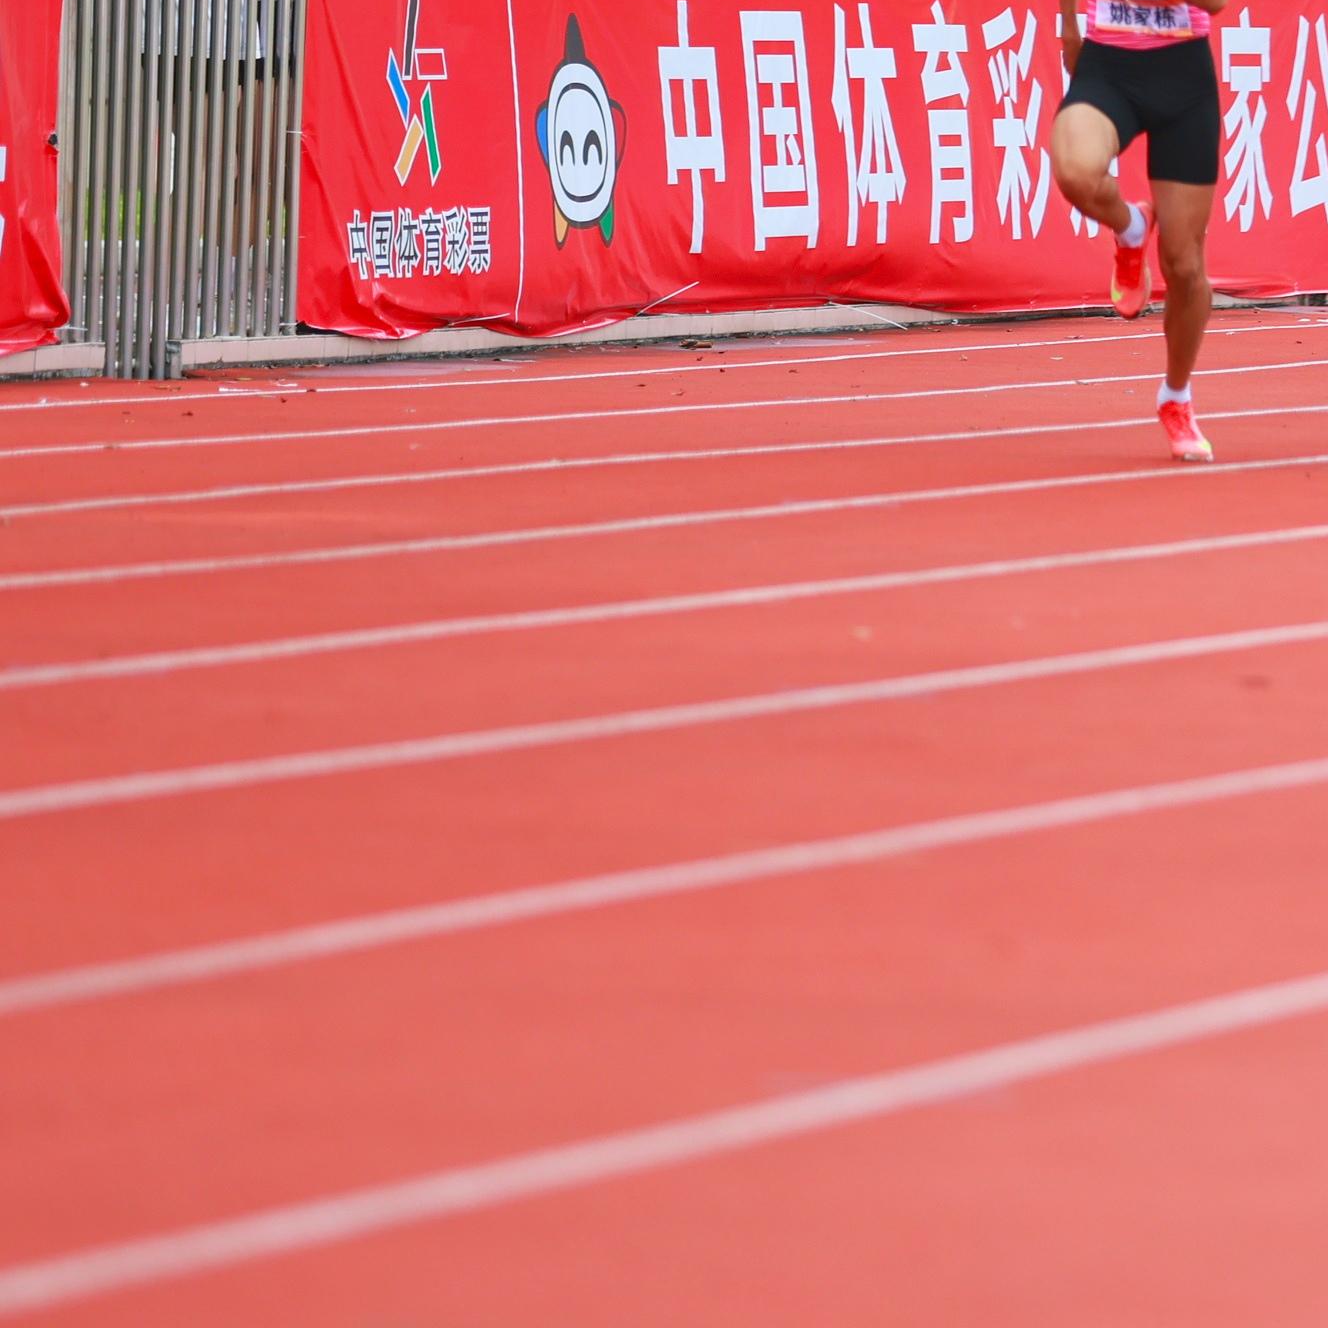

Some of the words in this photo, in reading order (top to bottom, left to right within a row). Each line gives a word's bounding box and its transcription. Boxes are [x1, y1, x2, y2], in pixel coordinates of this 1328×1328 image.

[347, 206, 491, 280] 中国体育彩票
